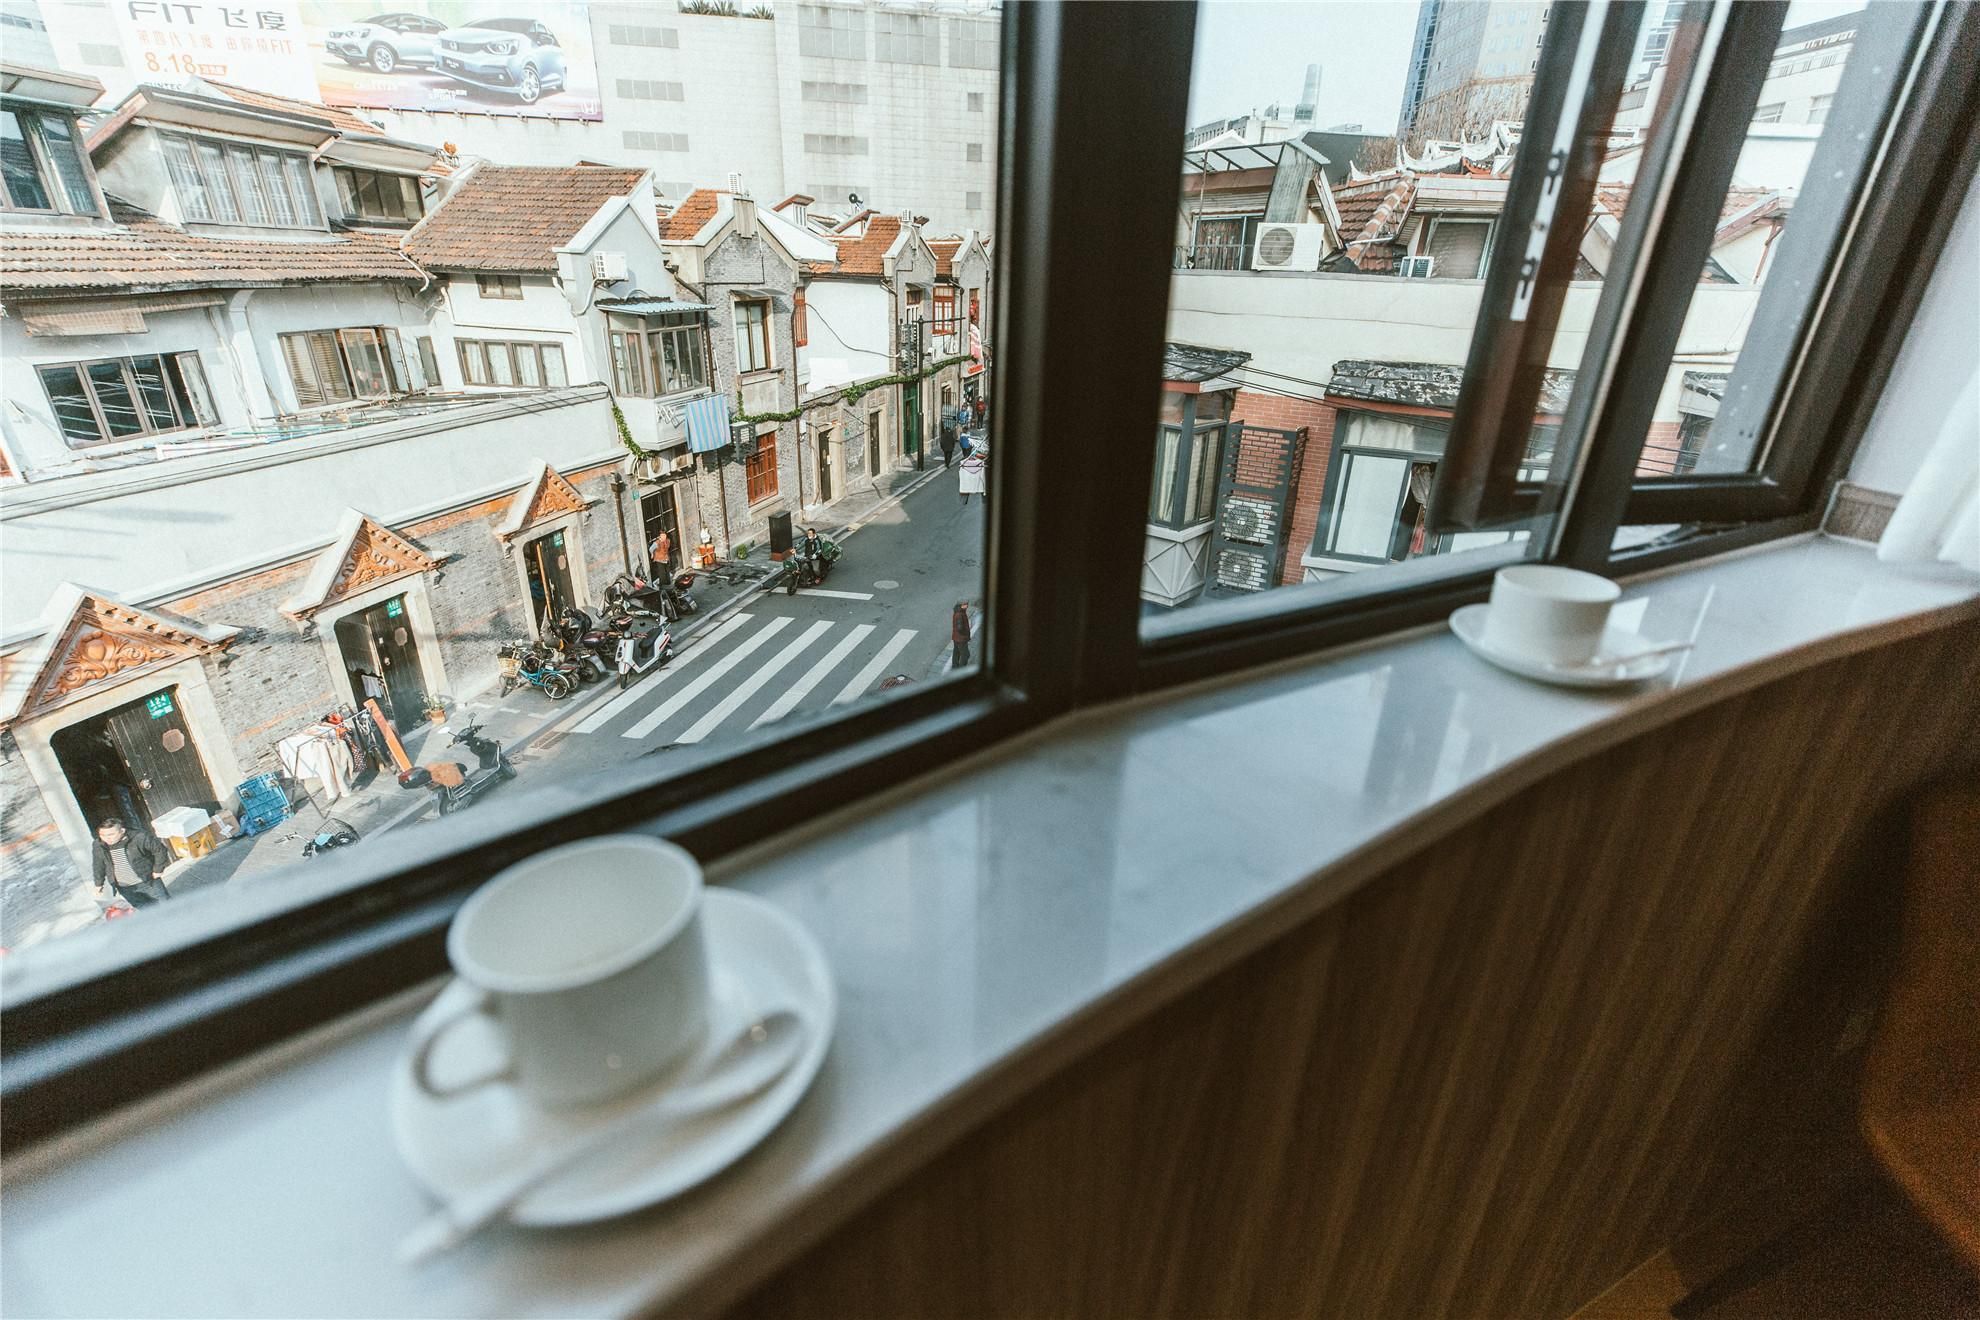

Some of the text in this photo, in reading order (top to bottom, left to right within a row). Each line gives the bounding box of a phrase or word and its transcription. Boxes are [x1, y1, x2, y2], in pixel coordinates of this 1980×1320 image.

[128, 1, 287, 32] FIT 飞度
[144, 51, 197, 75] 8.18
